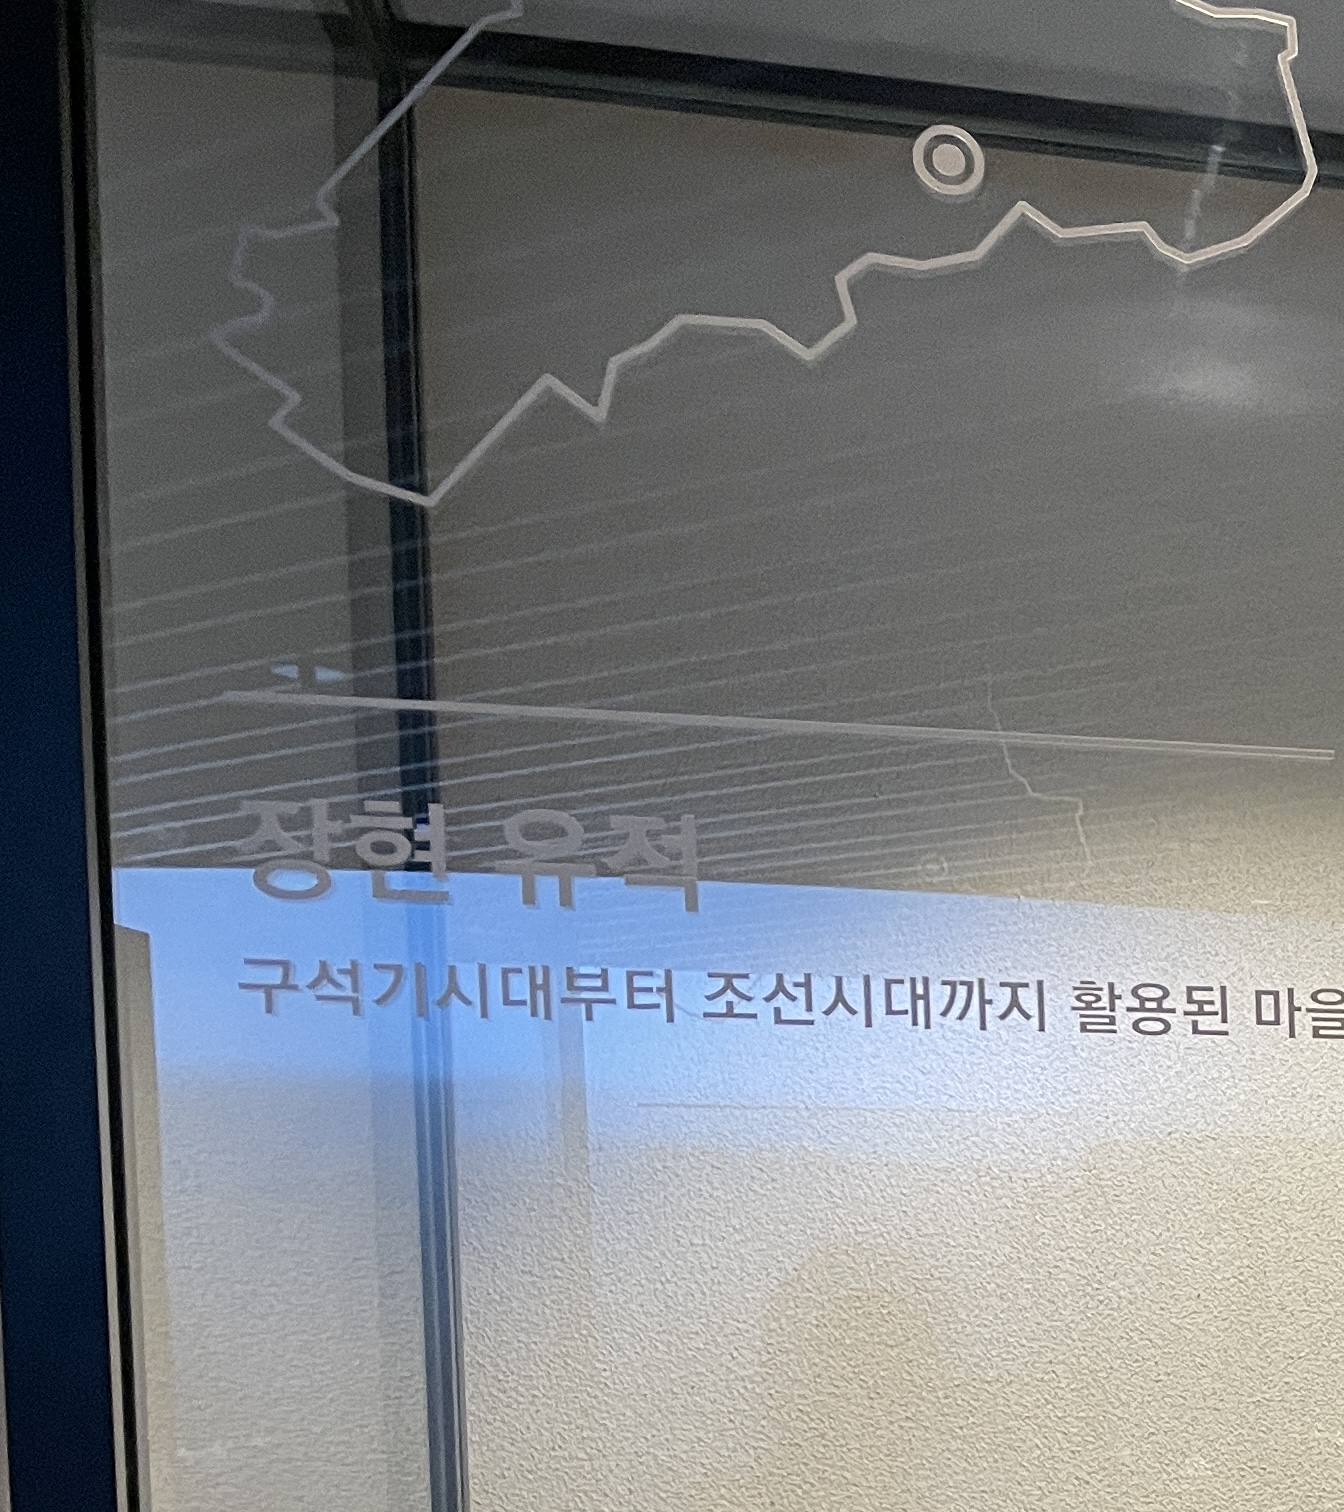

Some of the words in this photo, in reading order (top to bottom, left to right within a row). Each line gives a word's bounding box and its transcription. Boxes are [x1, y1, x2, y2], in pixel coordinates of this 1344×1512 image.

[234, 798, 451, 901] 장현
[492, 809, 699, 914] 유적
[238, 957, 676, 1024] 구석기시대부터
[702, 971, 1046, 1033] 조선시대까지
[1071, 978, 1231, 1037] 활용된
